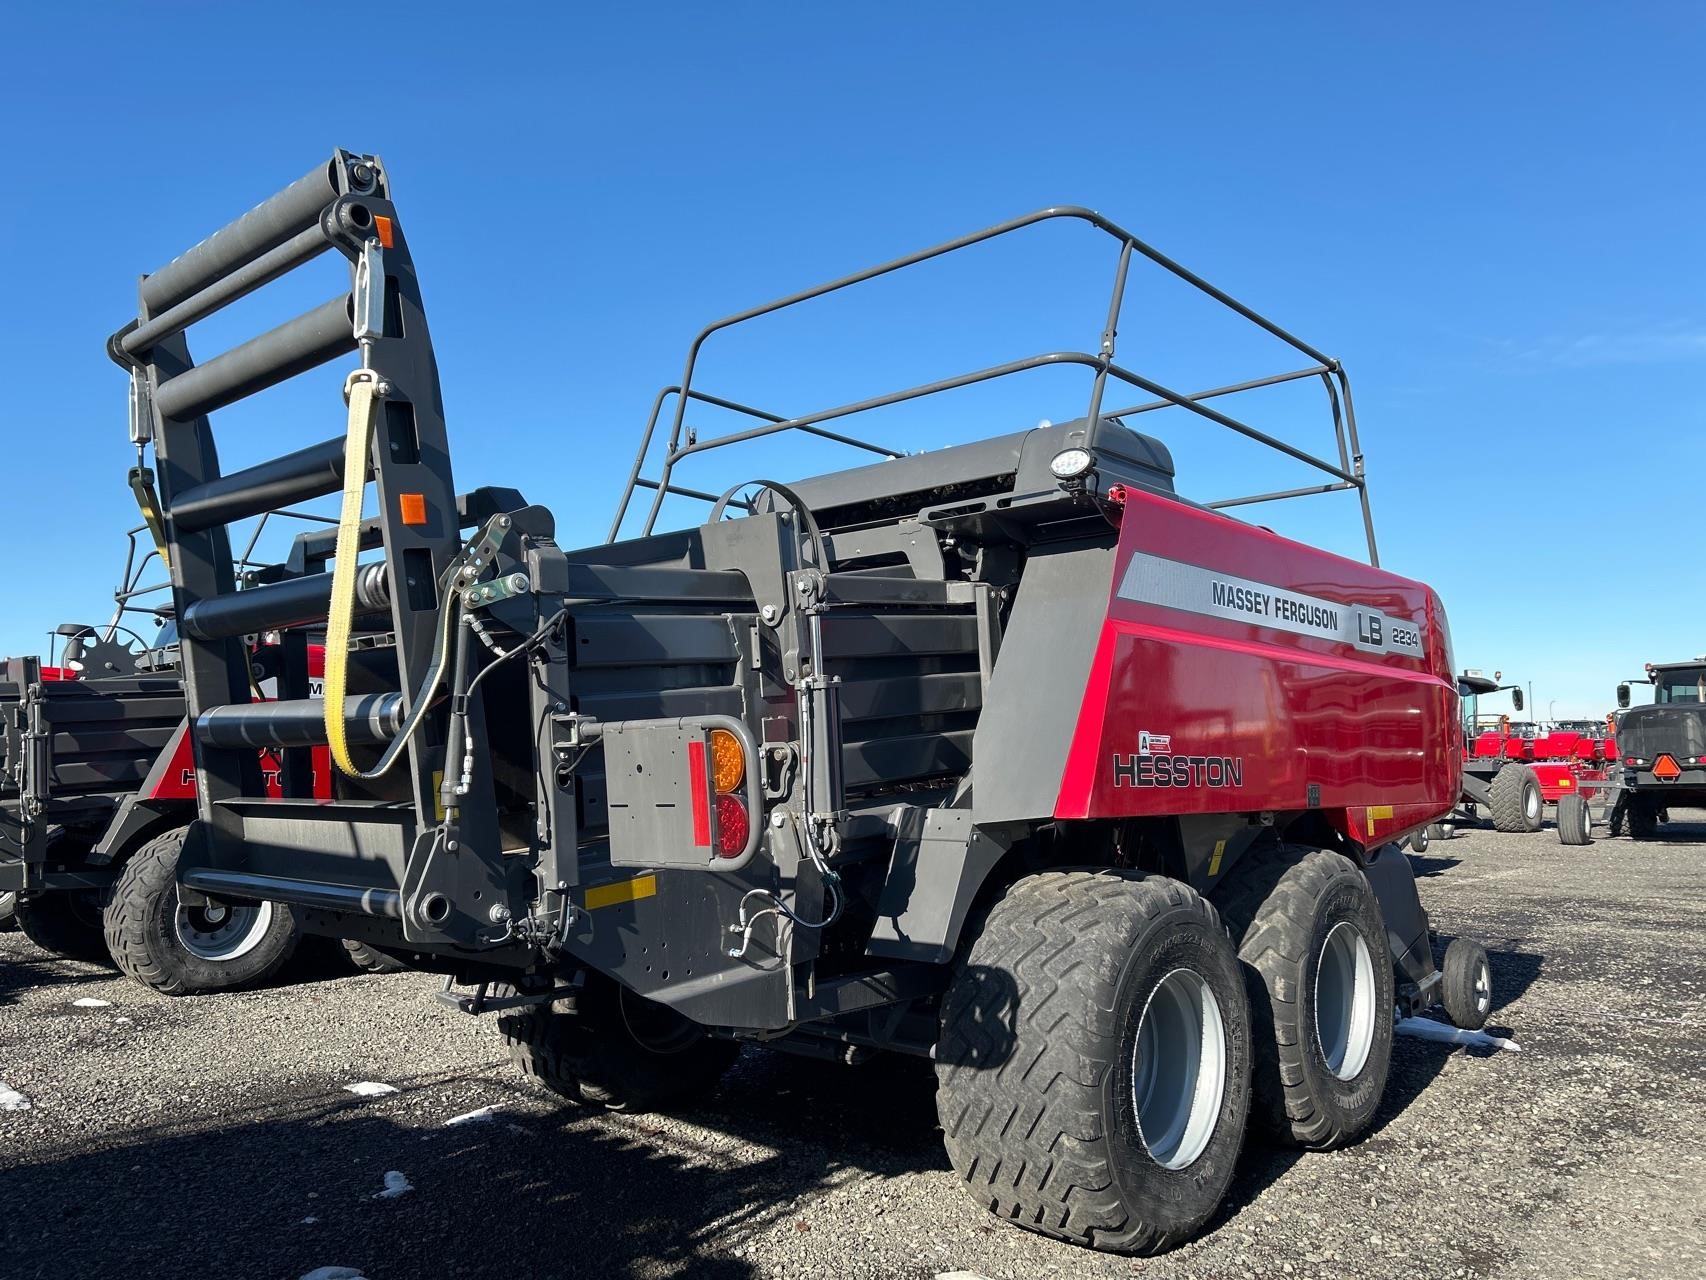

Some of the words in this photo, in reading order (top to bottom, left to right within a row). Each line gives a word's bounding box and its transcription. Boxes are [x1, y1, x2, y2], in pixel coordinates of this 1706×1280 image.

[1212, 581, 1270, 616] MASSEY
[1274, 597, 1338, 631] FERGUSON
[1357, 612, 1383, 646] LB
[1392, 627, 1419, 648] 2234
[1113, 753, 1243, 788] HESSTON
